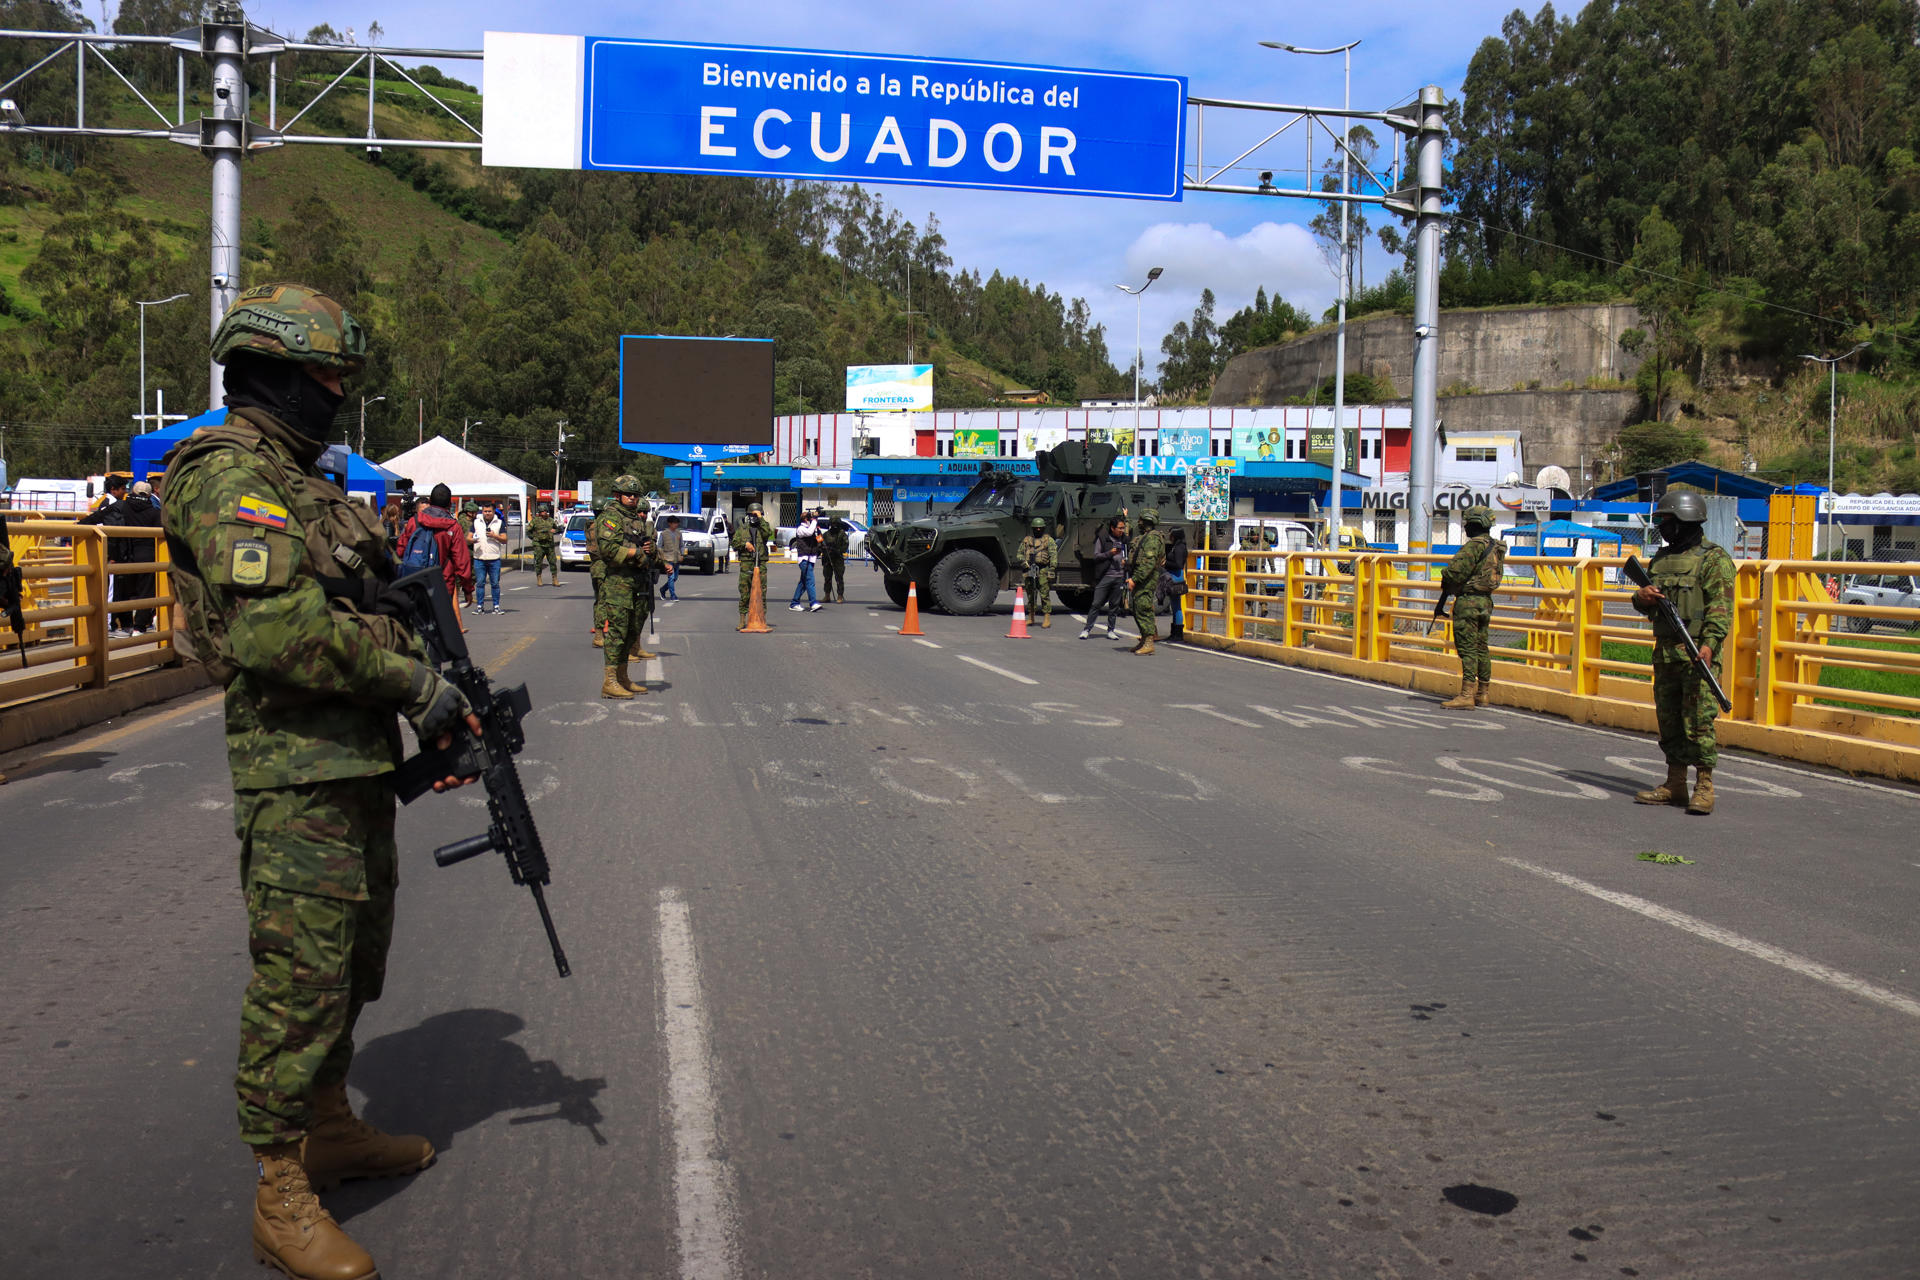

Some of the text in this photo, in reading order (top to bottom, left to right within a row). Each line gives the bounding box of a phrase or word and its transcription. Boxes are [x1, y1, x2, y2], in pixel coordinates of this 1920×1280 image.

[702, 62, 1080, 109] Bienvenido a la República del
[699, 105, 1077, 177] ECUADOR
[863, 396, 914, 404] FRONTERAS
[947, 463, 1031, 473] ADUANA ECUADOR
[1362, 488, 1490, 510] MIGCIÓN
[235, 542, 268, 551] INFANTERIA
[1164, 703, 1508, 731] TAXIS
[760, 756, 1217, 808] SOLO
